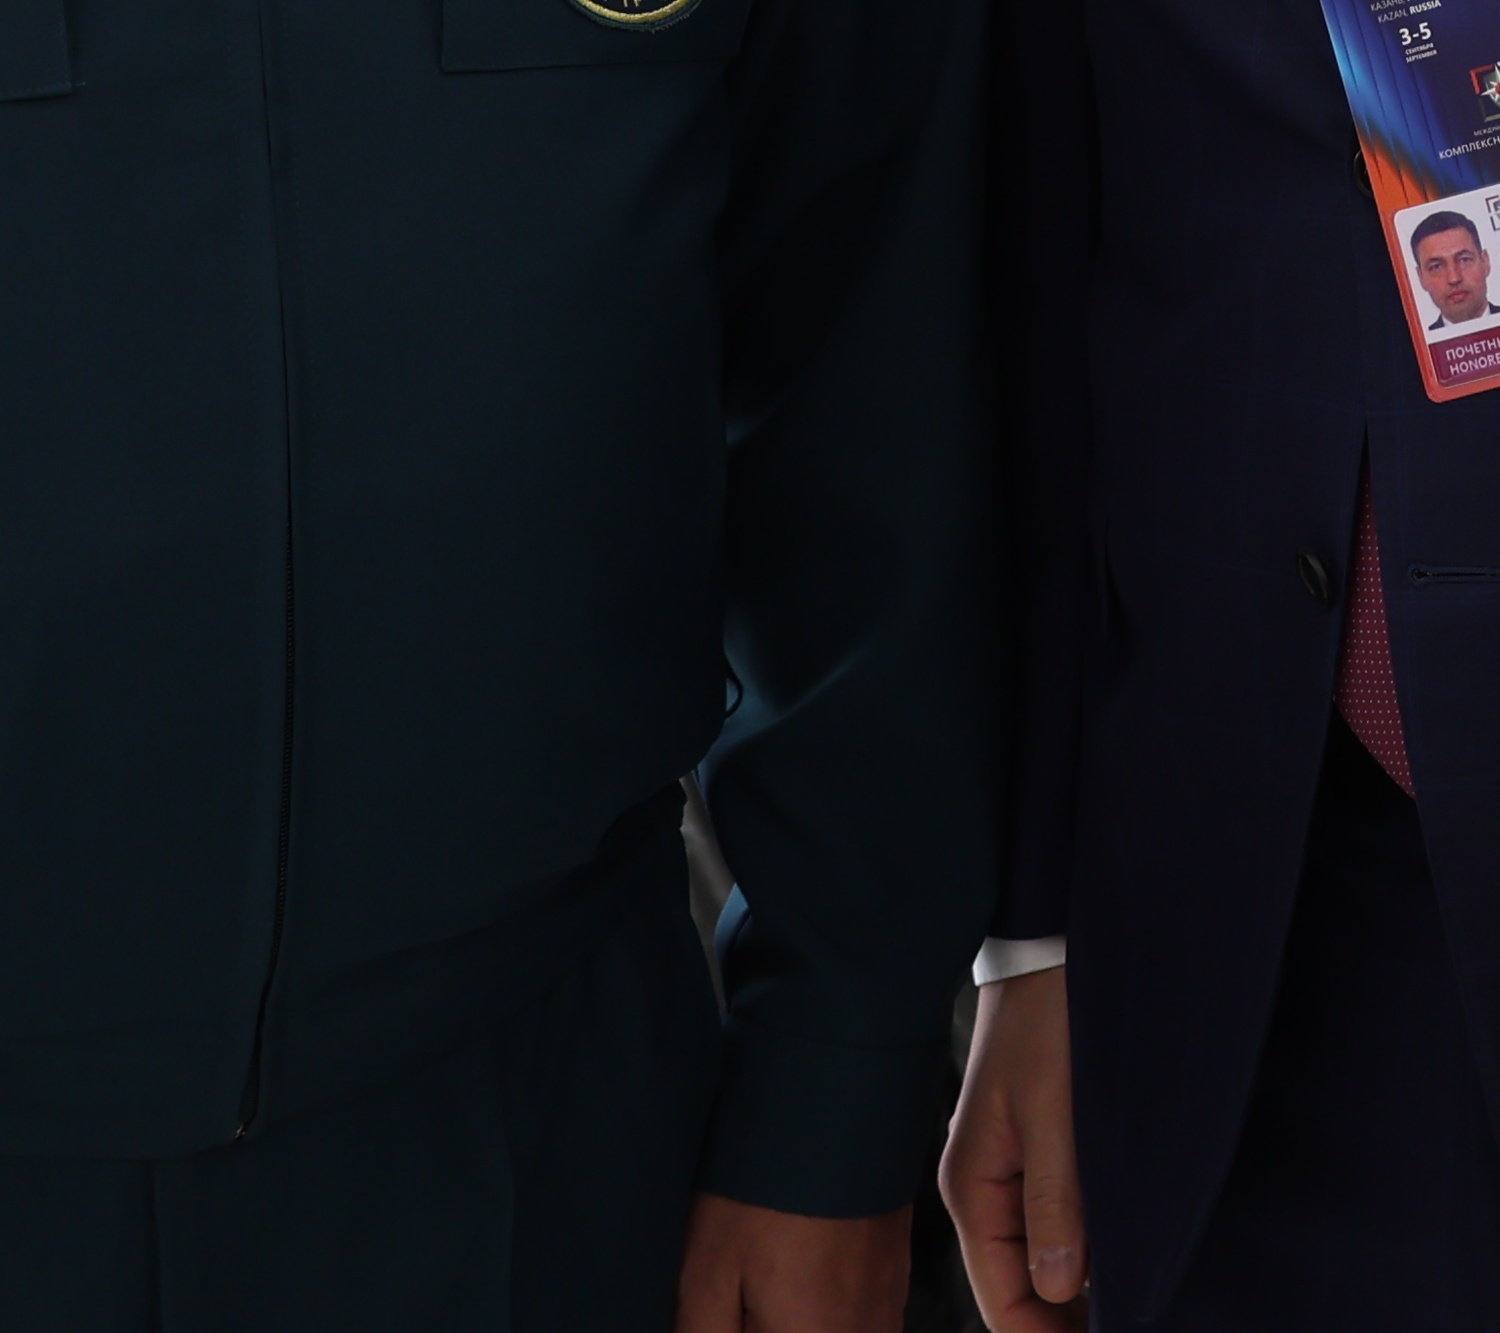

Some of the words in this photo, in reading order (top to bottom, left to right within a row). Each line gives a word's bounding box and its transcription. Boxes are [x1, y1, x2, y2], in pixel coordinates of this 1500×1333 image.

[1409, 0, 1442, 15] RUSSIA
[1398, 21, 1432, 46] 3-5
[1405, 49, 1438, 63] SEPTEMBER
